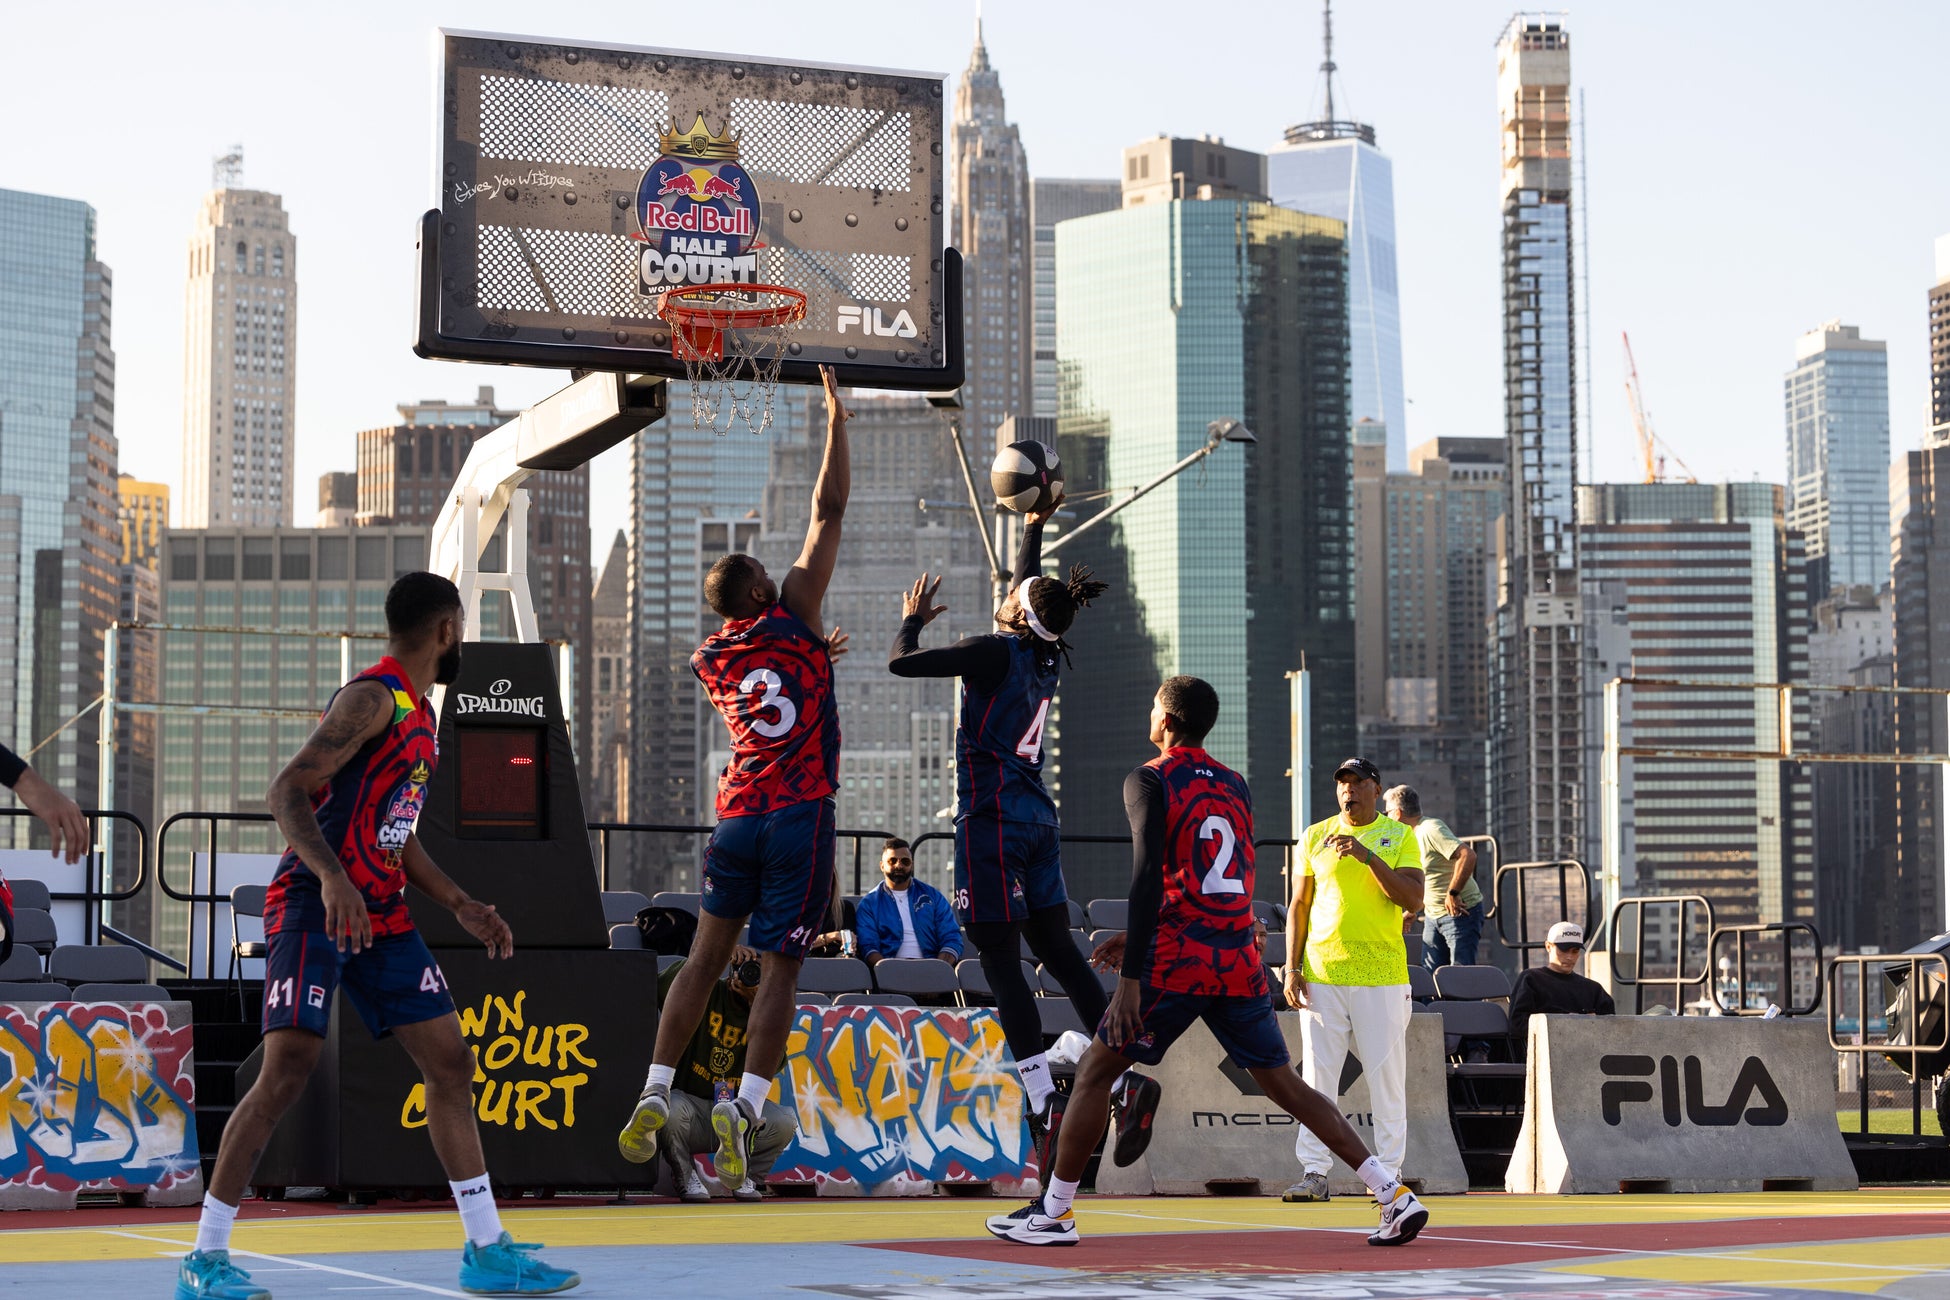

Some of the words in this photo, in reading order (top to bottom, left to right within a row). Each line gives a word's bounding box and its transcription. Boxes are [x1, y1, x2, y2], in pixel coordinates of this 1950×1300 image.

[647, 202, 699, 231] Red
[701, 206, 750, 235] Bull
[671, 236, 726, 255] HALF
[641, 249, 756, 285] COURT
[838, 305, 917, 338] FILA
[457, 694, 544, 718] SPALDING
[739, 668, 797, 738] 3
[1016, 698, 1050, 764] 4
[379, 824, 410, 844] COU
[394, 820, 411, 830] HAL
[1200, 816, 1245, 894] 2
[791, 925, 812, 945] 41
[268, 977, 293, 1008] 41
[456, 990, 526, 1037] WN
[472, 1024, 598, 1082] OUR
[1021, 1063, 1040, 1075] FILA
[692, 1062, 711, 1081] ROSS
[401, 1072, 588, 1131] CURT
[1600, 1055, 1788, 1127] FILA
[1193, 1111, 1374, 1128] MCDI
[461, 1185, 487, 1197] FILA
